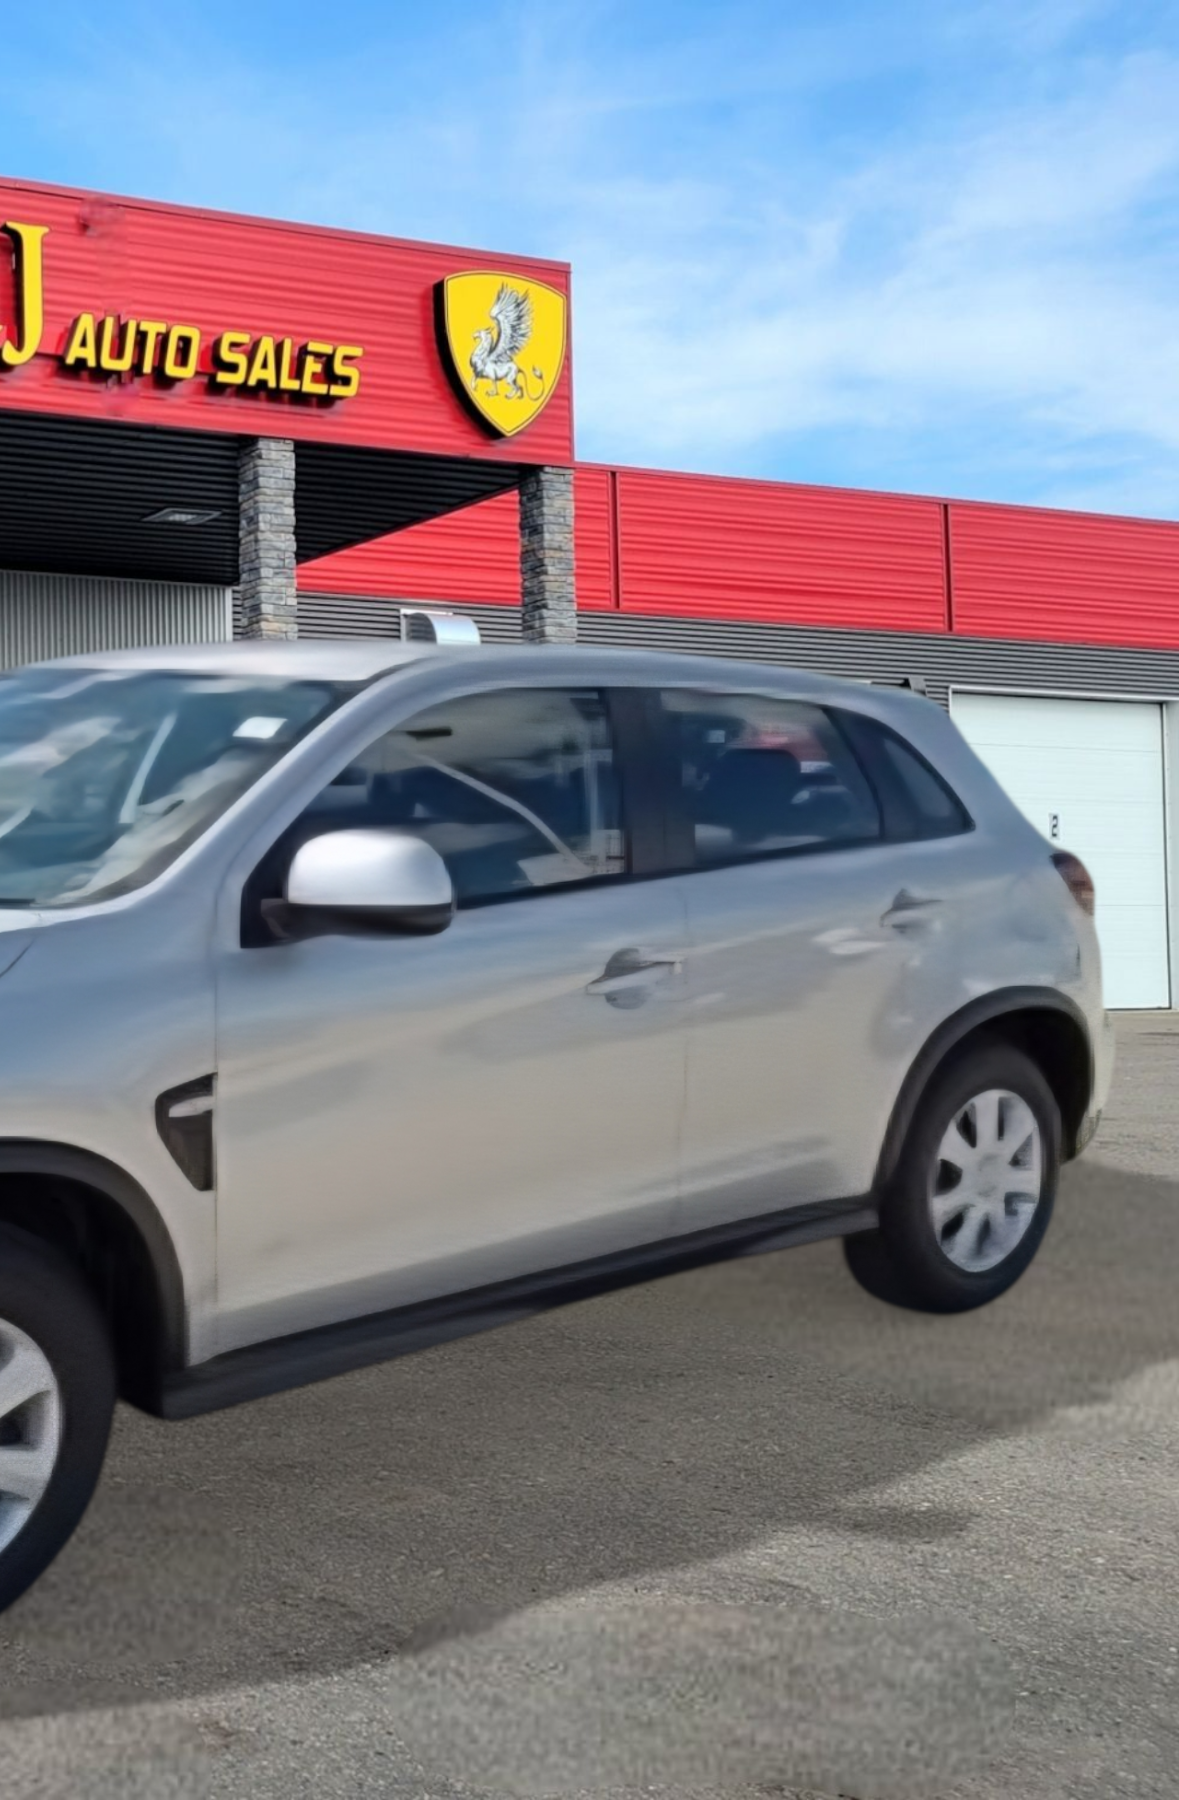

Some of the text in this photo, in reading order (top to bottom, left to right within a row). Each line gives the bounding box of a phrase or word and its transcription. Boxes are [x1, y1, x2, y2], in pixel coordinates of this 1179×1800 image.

[65, 313, 201, 379] AUTO
[216, 331, 364, 397] SALES
[1051, 814, 1059, 838] 2
